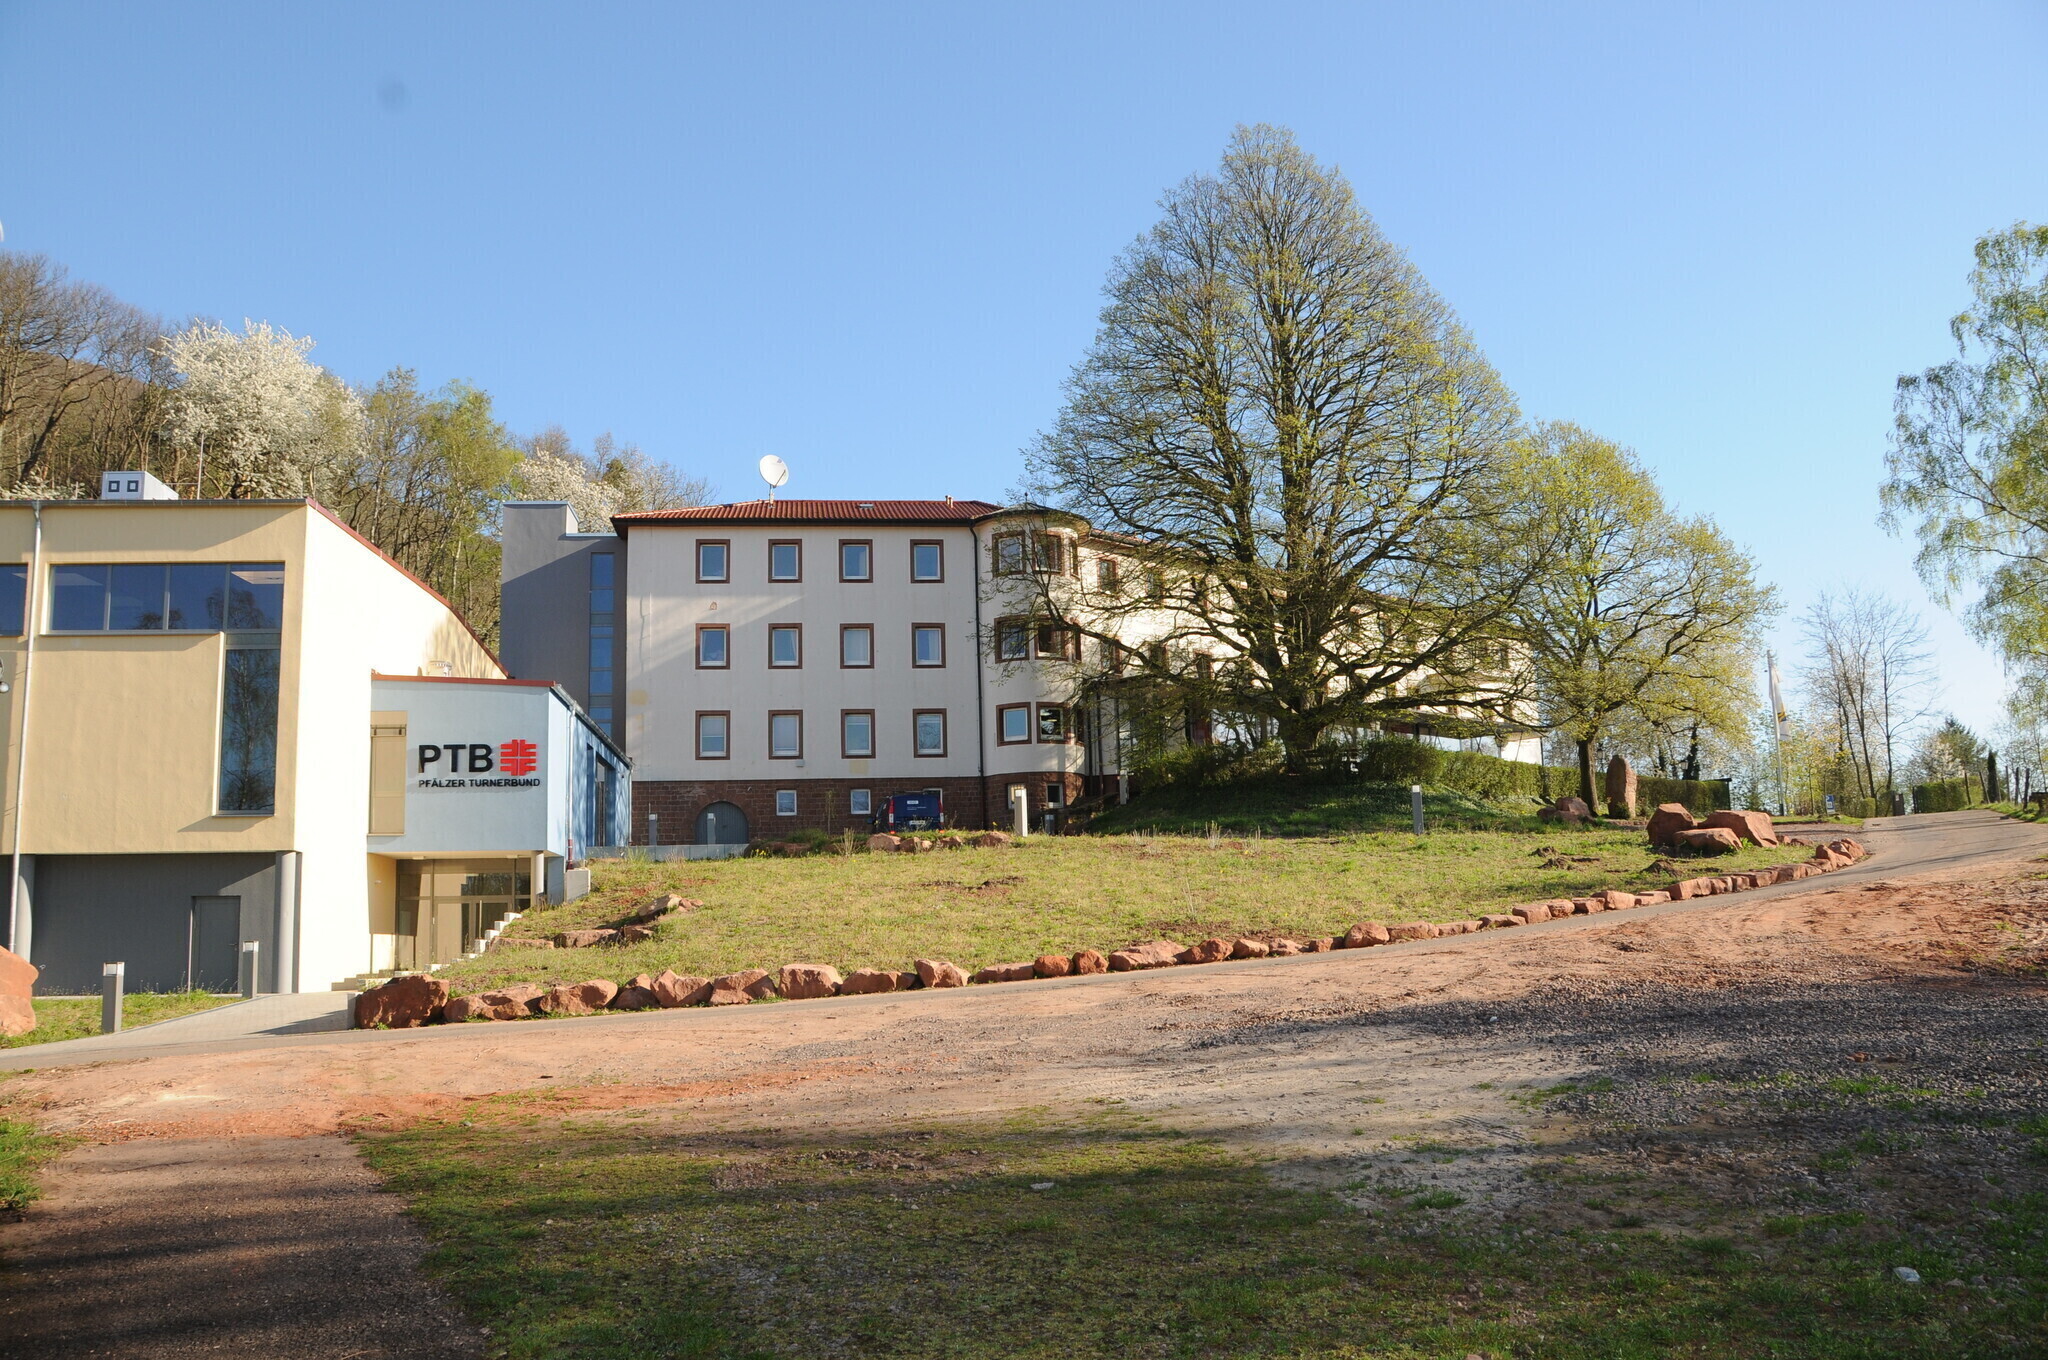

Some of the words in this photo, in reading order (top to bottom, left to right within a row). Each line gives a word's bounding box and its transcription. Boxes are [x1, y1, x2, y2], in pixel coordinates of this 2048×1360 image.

[418, 744, 493, 773] PTB
[418, 778, 466, 788] PFÄLZER
[468, 778, 541, 788] TURNERBUND
